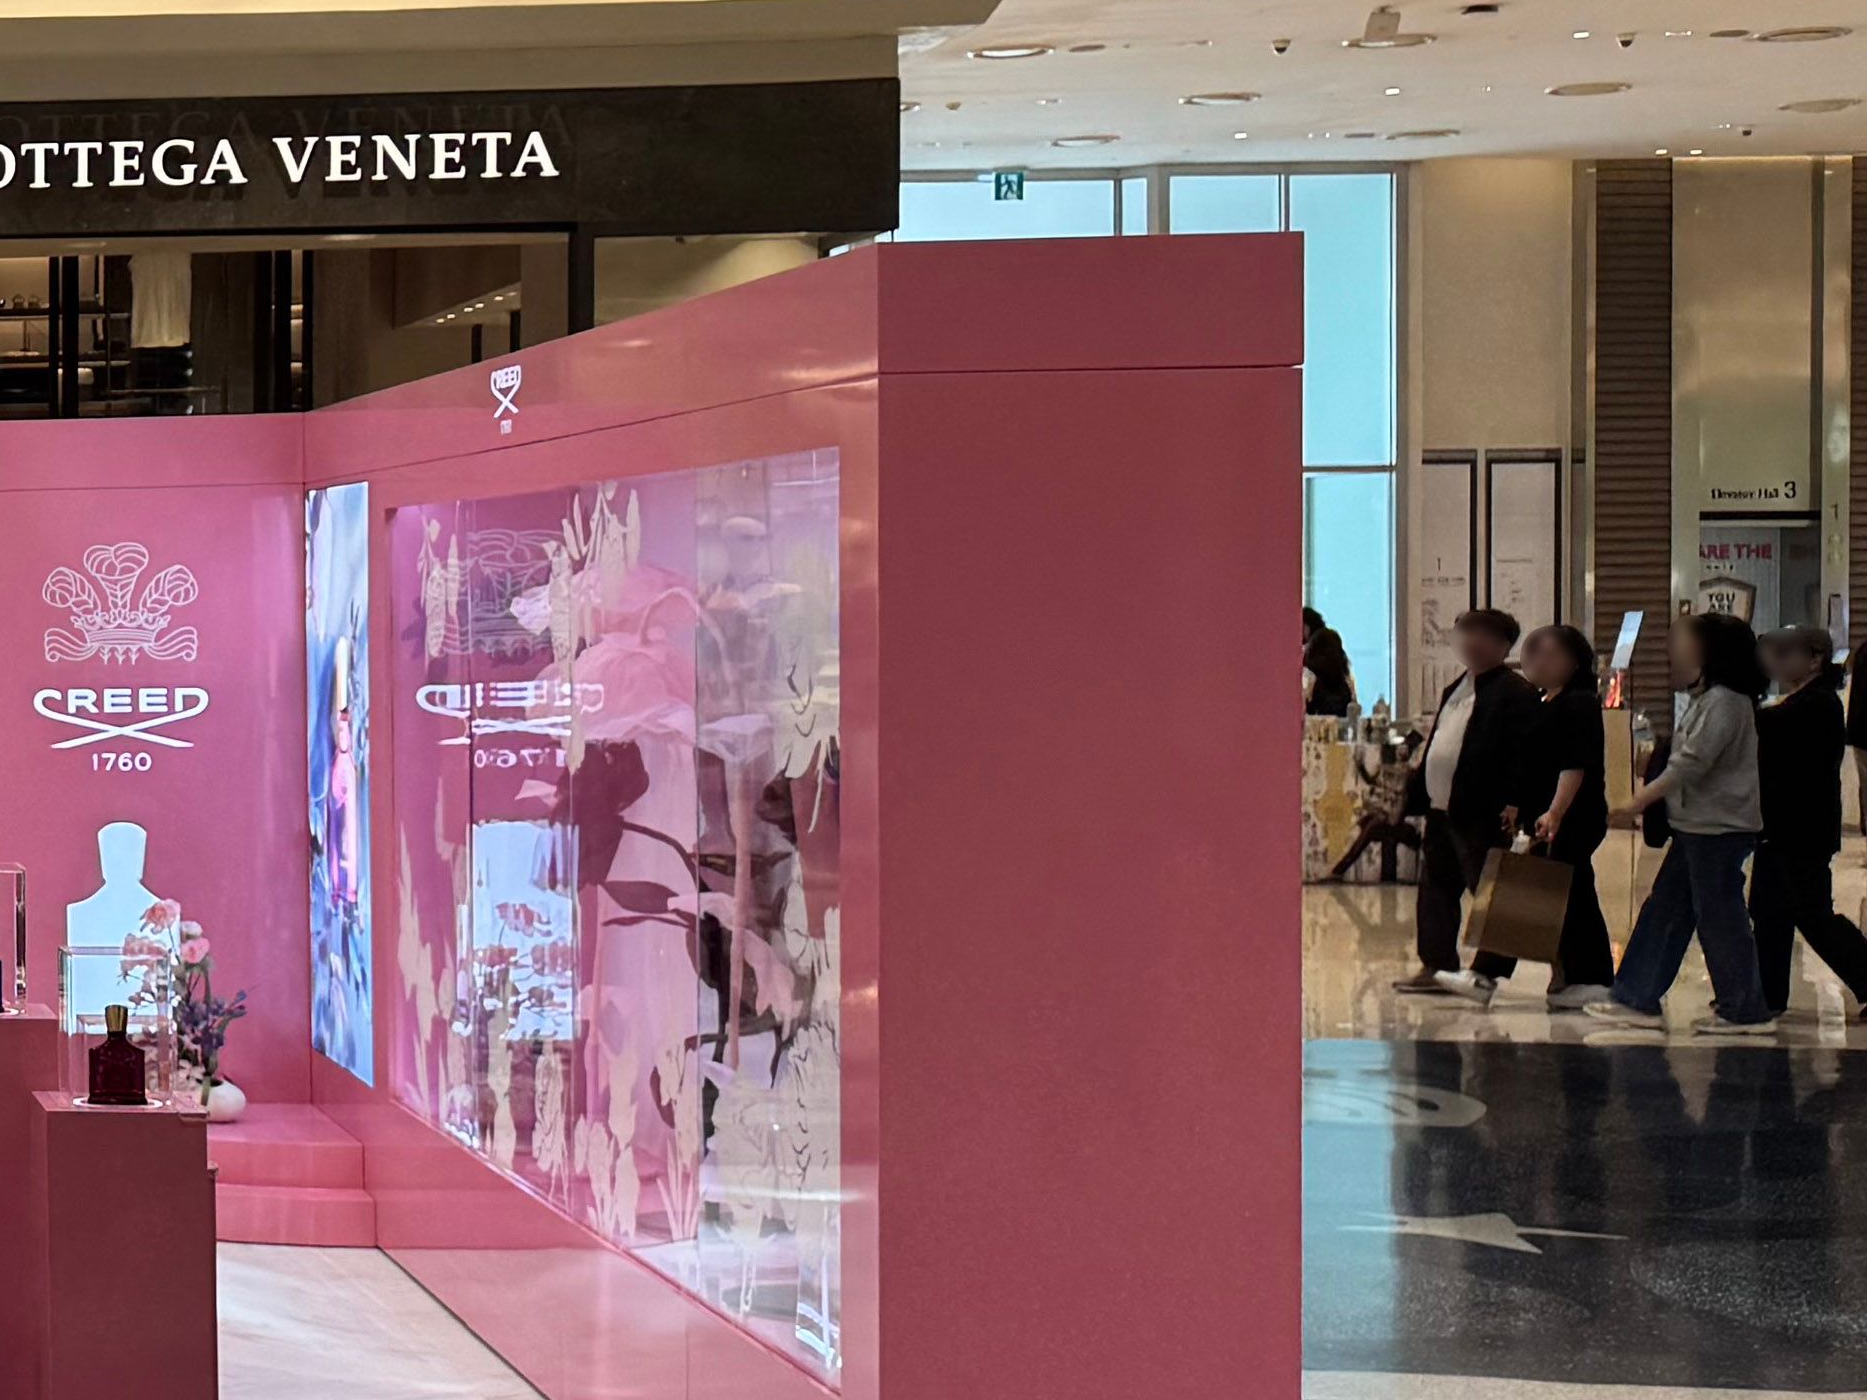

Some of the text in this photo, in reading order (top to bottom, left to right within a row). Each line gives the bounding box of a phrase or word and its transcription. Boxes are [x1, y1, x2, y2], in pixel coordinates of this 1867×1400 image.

[272, 131, 559, 183] VENETA
[1784, 481, 1796, 499] 3
[1734, 543, 1772, 560] THE
[33, 686, 209, 749] CREED
[91, 752, 152, 771] 1760
